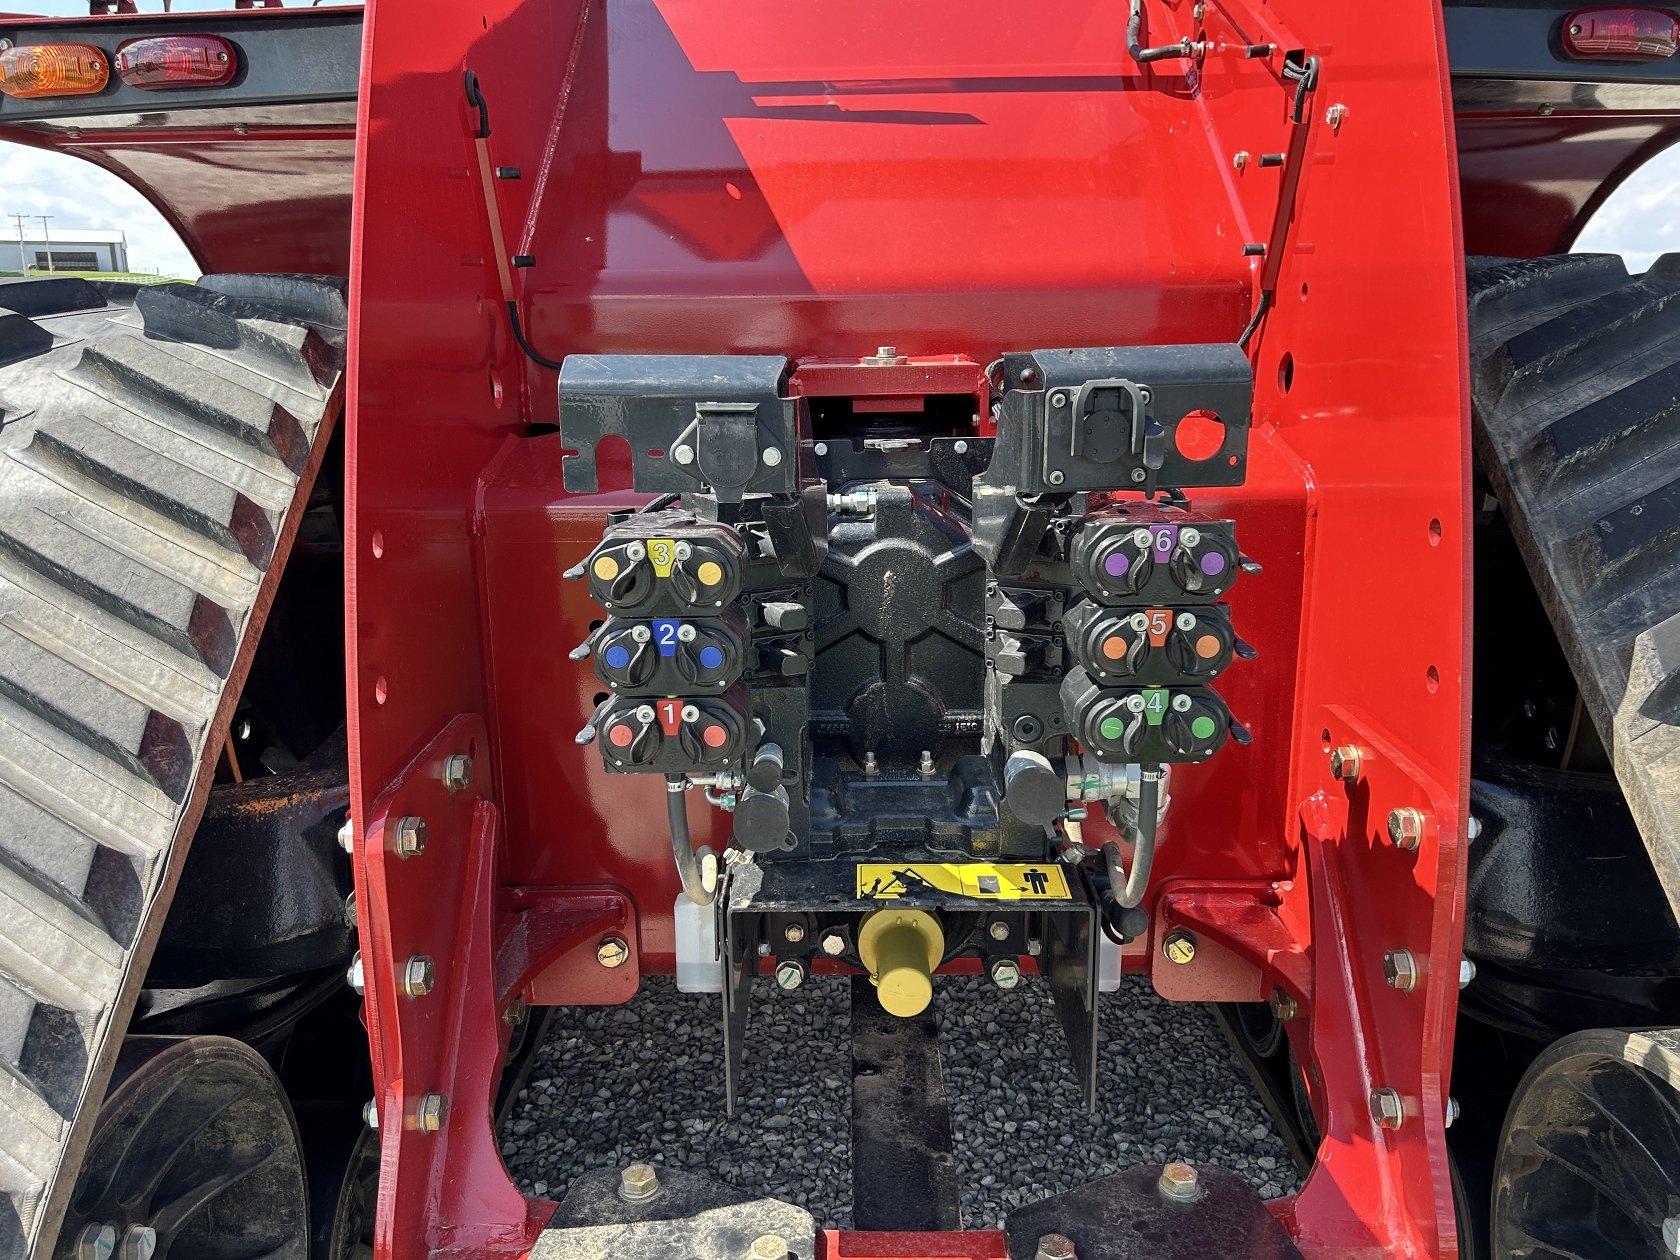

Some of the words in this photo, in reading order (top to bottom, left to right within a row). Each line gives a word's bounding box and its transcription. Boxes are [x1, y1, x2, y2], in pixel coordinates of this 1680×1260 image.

[1155, 529, 1172, 552] 6
[652, 543, 670, 566] 3
[659, 623, 676, 645] 2
[1150, 613, 1167, 635] 5
[663, 703, 674, 724] 1
[1146, 693, 1163, 713] 4
